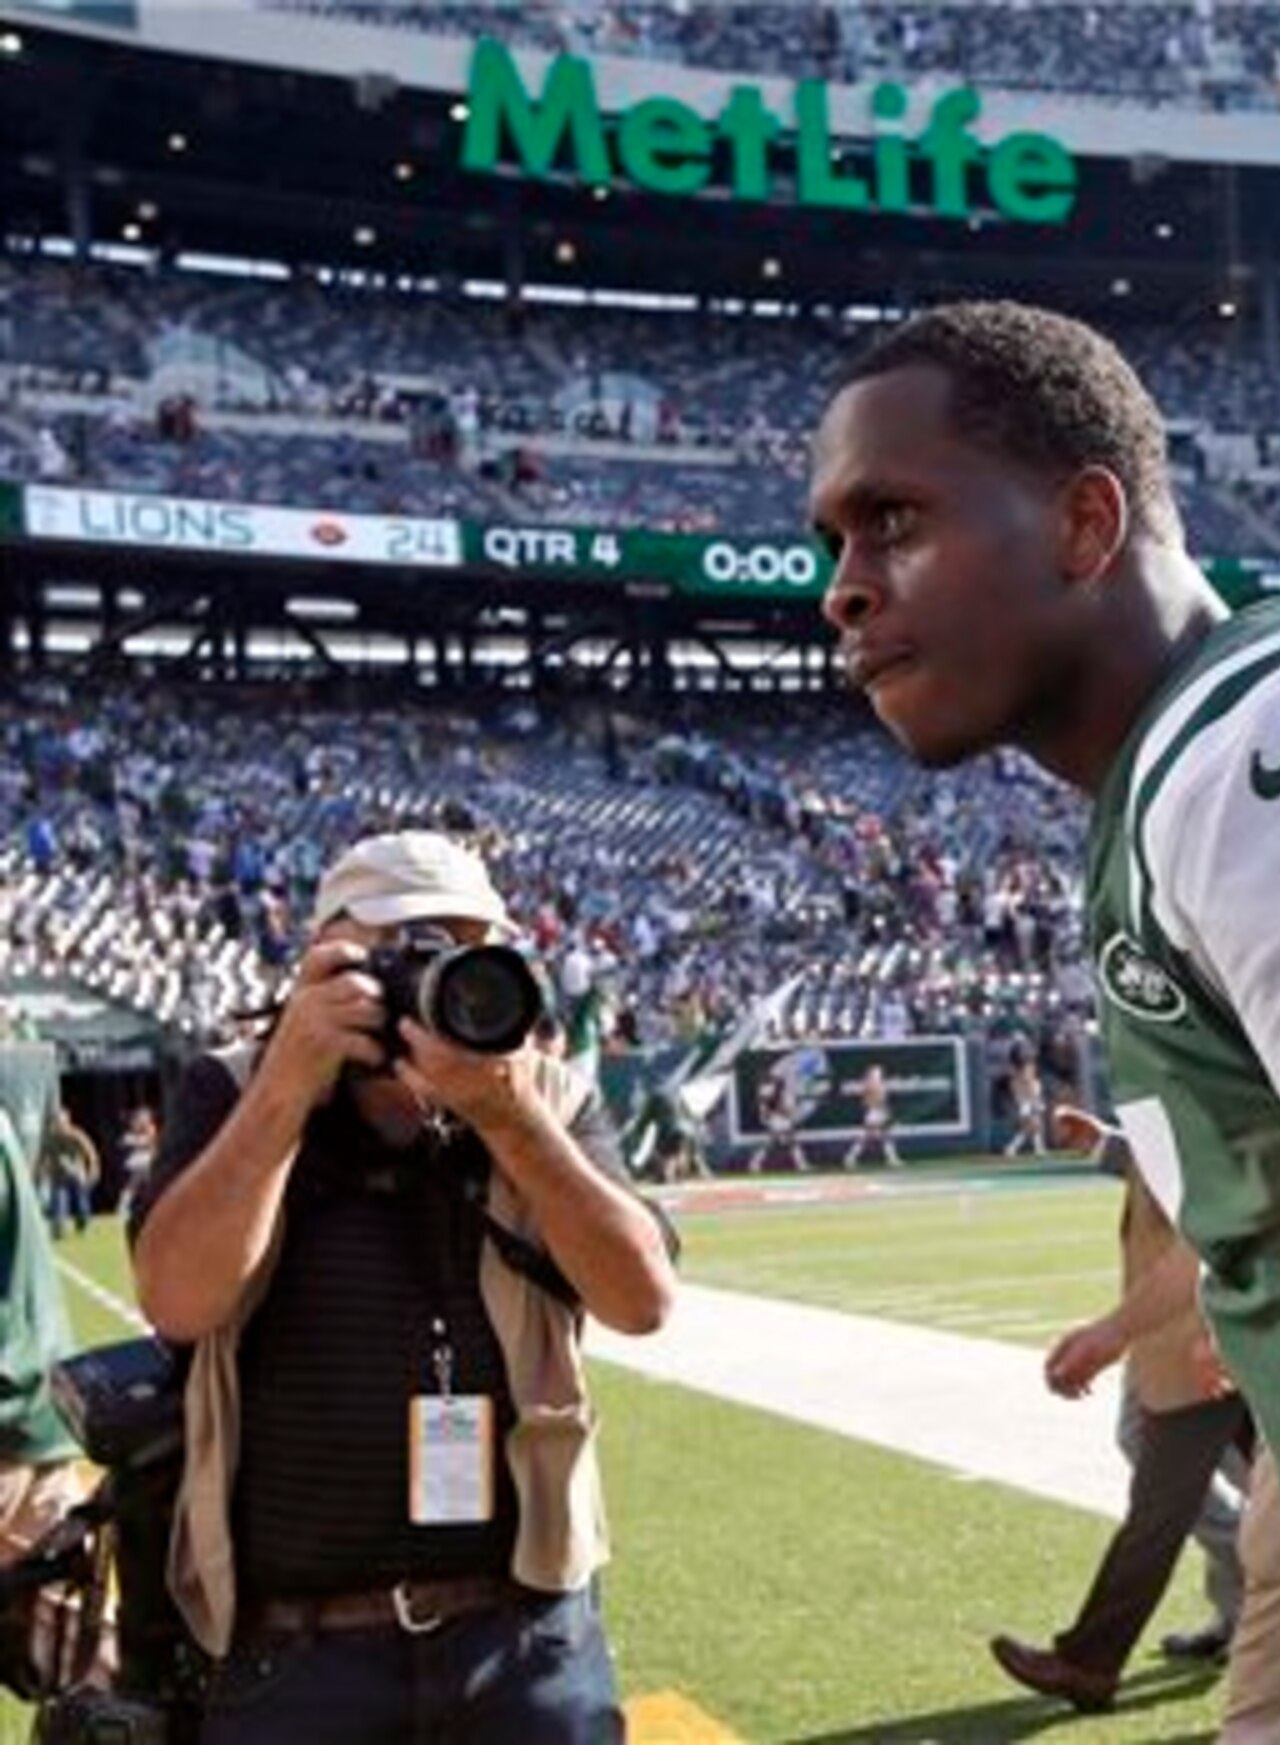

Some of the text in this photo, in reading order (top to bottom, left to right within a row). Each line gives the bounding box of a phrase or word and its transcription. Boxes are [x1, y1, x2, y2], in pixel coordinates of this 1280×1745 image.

[461, 36, 1078, 222] MetLife
[80, 498, 255, 547] LIONS
[384, 523, 448, 561] 24
[484, 528, 621, 568] QTR 4
[703, 542, 816, 585] 0:00
